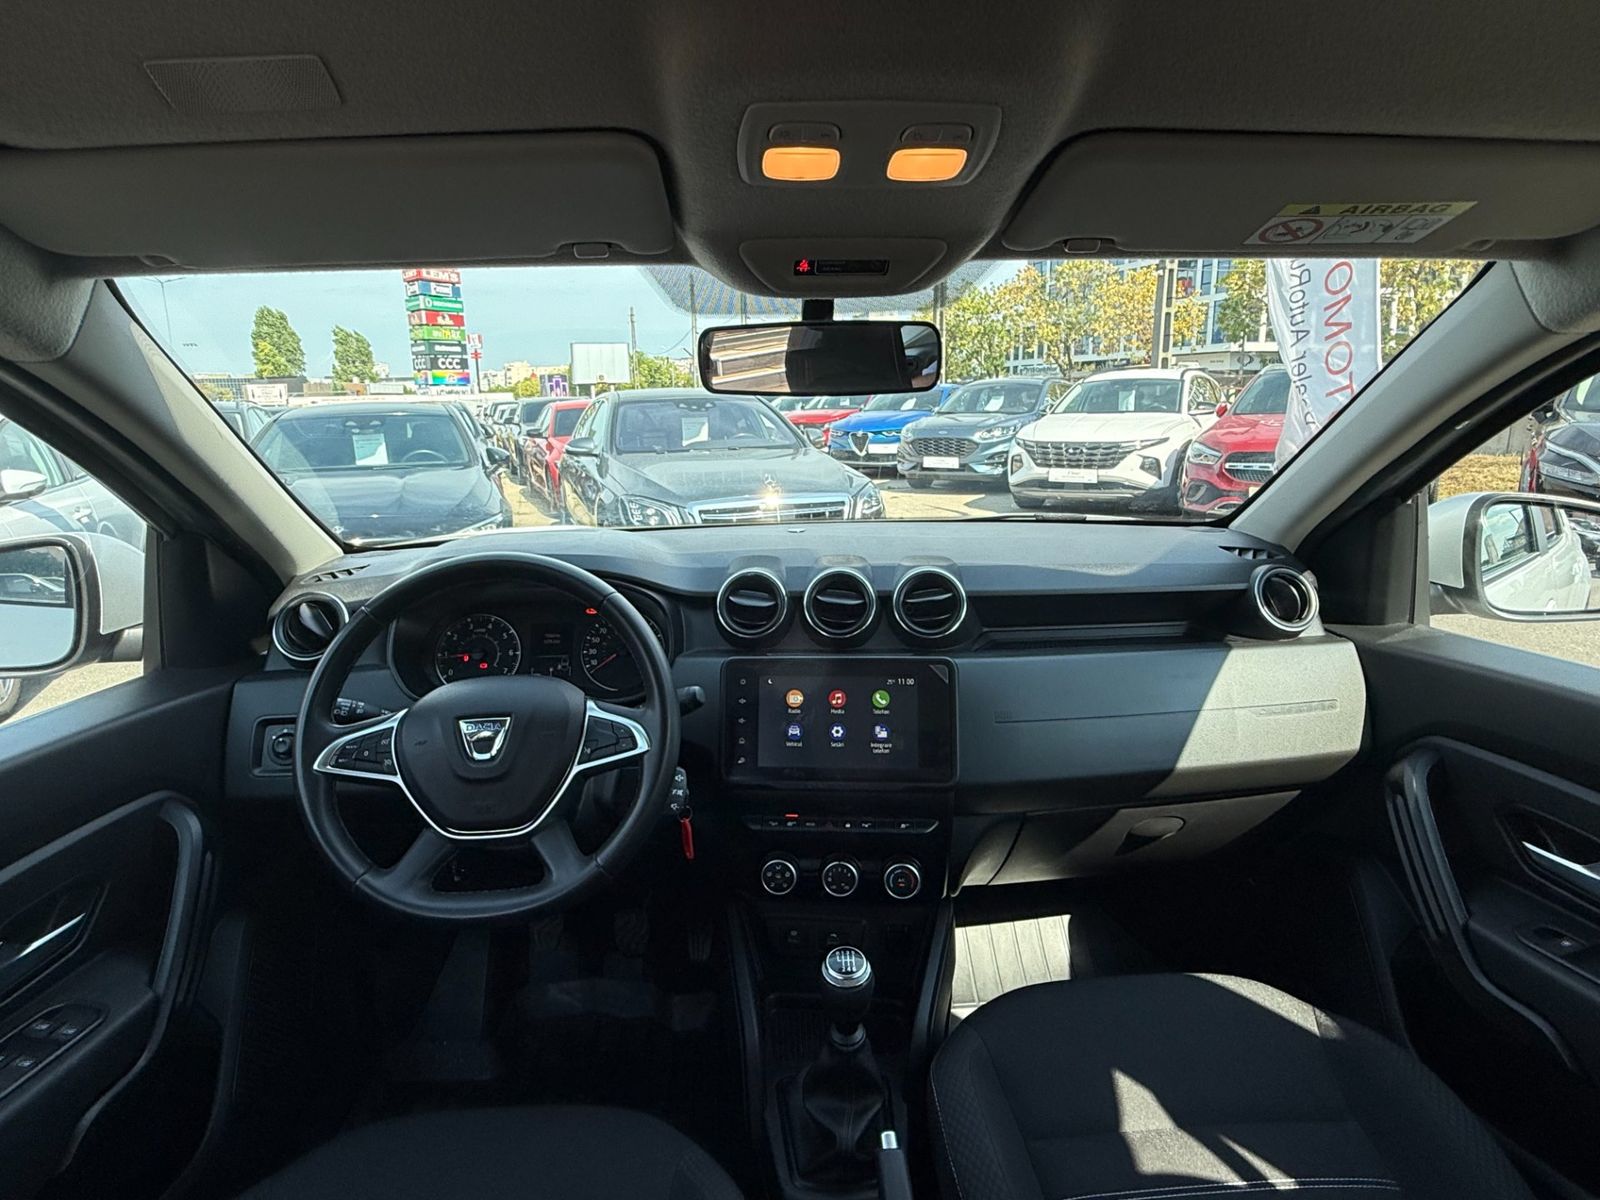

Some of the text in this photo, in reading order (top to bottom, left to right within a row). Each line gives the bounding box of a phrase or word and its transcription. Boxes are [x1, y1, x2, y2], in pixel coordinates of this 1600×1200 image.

[1339, 203, 1451, 215] AIRBAG
[414, 358, 426, 369] CCC
[437, 357, 461, 369] CCC
[466, 722, 502, 732] DACIA
